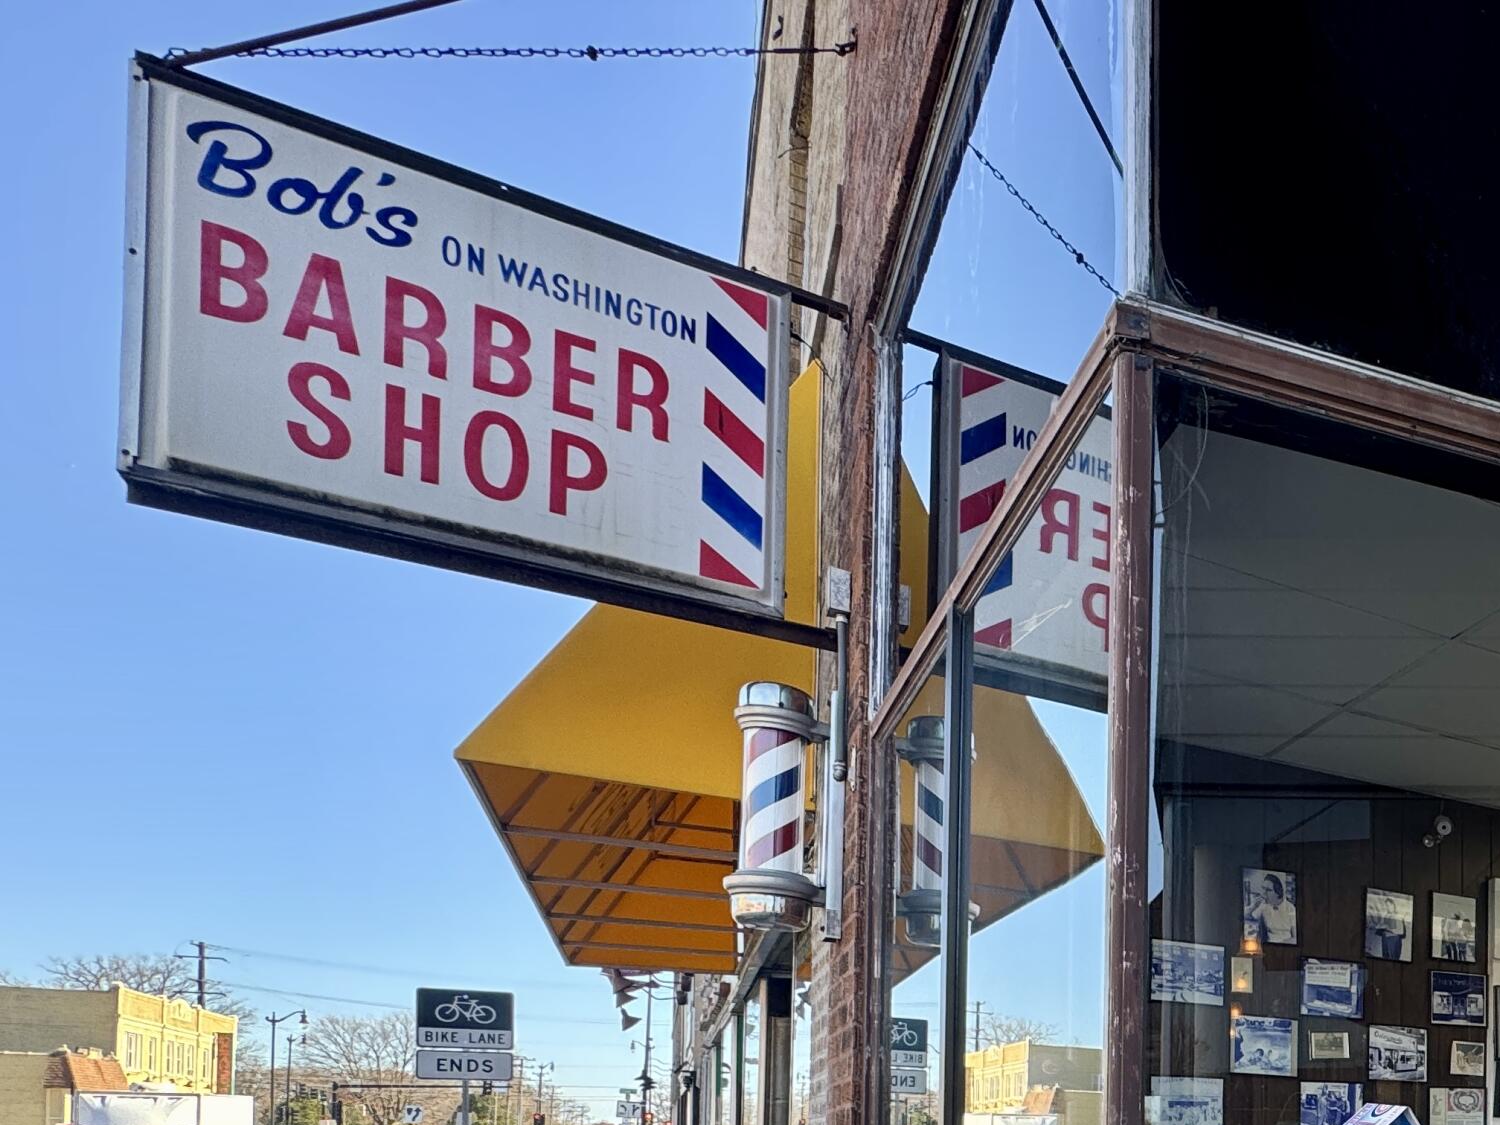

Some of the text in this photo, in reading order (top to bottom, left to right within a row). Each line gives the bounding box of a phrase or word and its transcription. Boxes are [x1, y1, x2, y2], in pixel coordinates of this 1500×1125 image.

[187, 120, 418, 248] Bob's
[199, 219, 670, 443] BARBER
[441, 235, 697, 344] ON WASHINGTON
[286, 361, 608, 515] SHOP
[425, 1031, 505, 1045] BIKE LANE
[437, 1058, 493, 1073] ENDS
